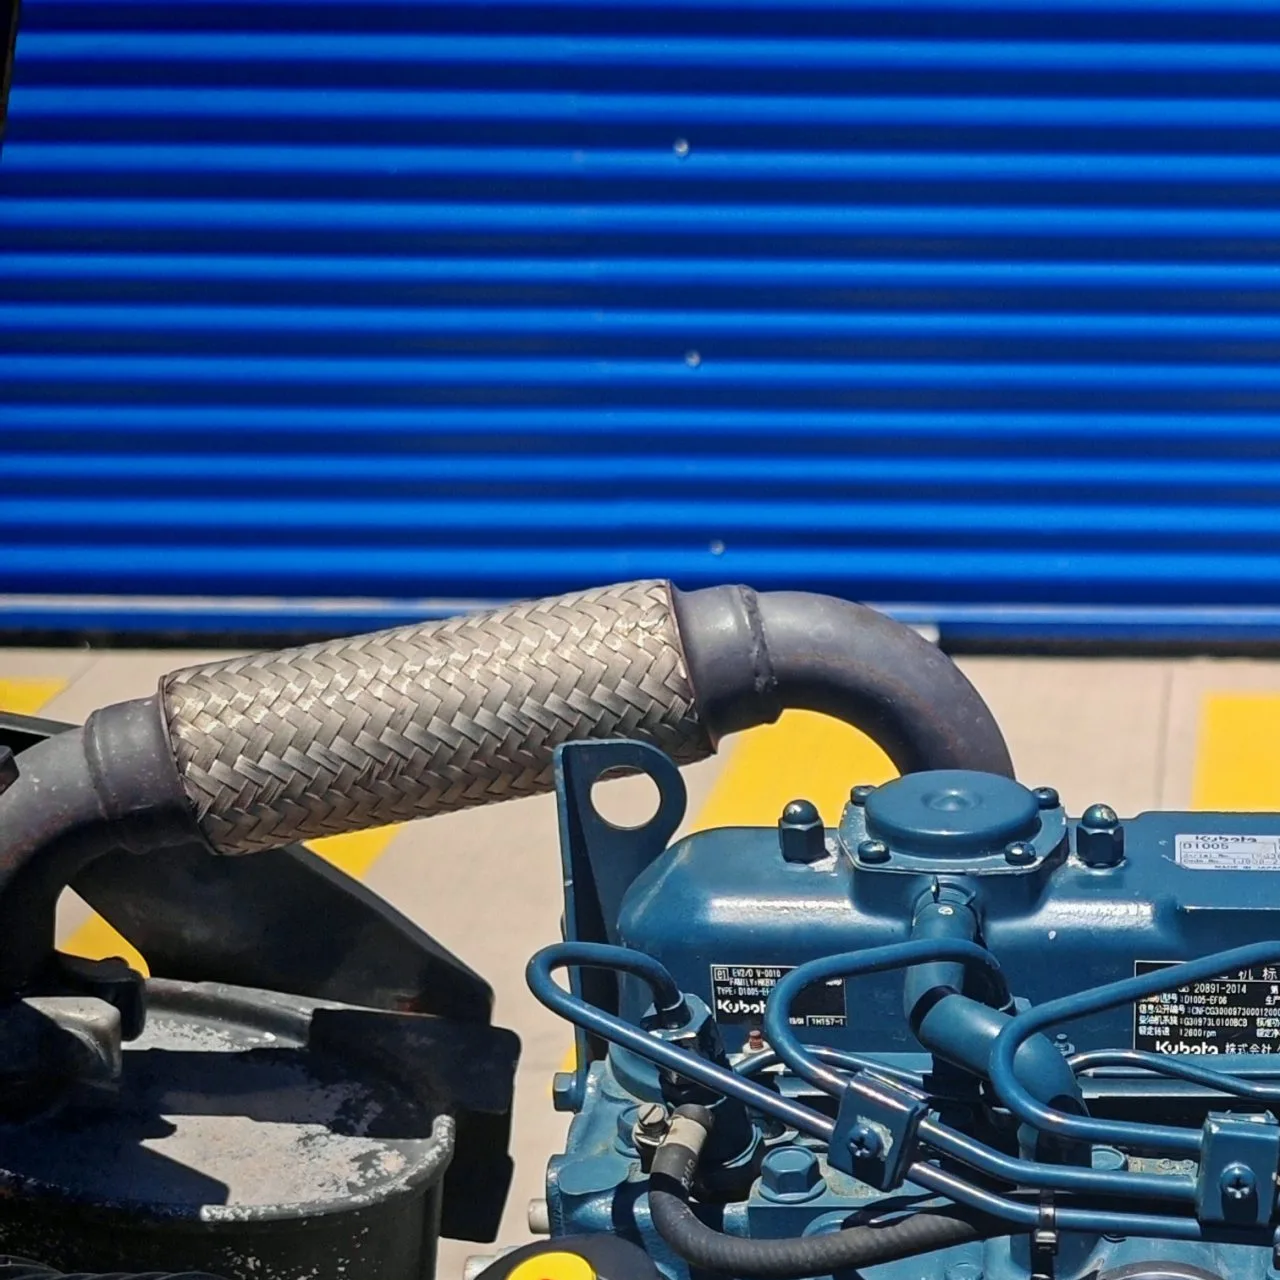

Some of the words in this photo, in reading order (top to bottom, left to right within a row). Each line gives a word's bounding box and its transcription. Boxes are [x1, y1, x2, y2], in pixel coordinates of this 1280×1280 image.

[1182, 842, 1230, 851] D1005
[1193, 984, 1247, 995] 20891-2014
[717, 1000, 767, 1014] Kubot
[1155, 1041, 1219, 1055] Kubota
